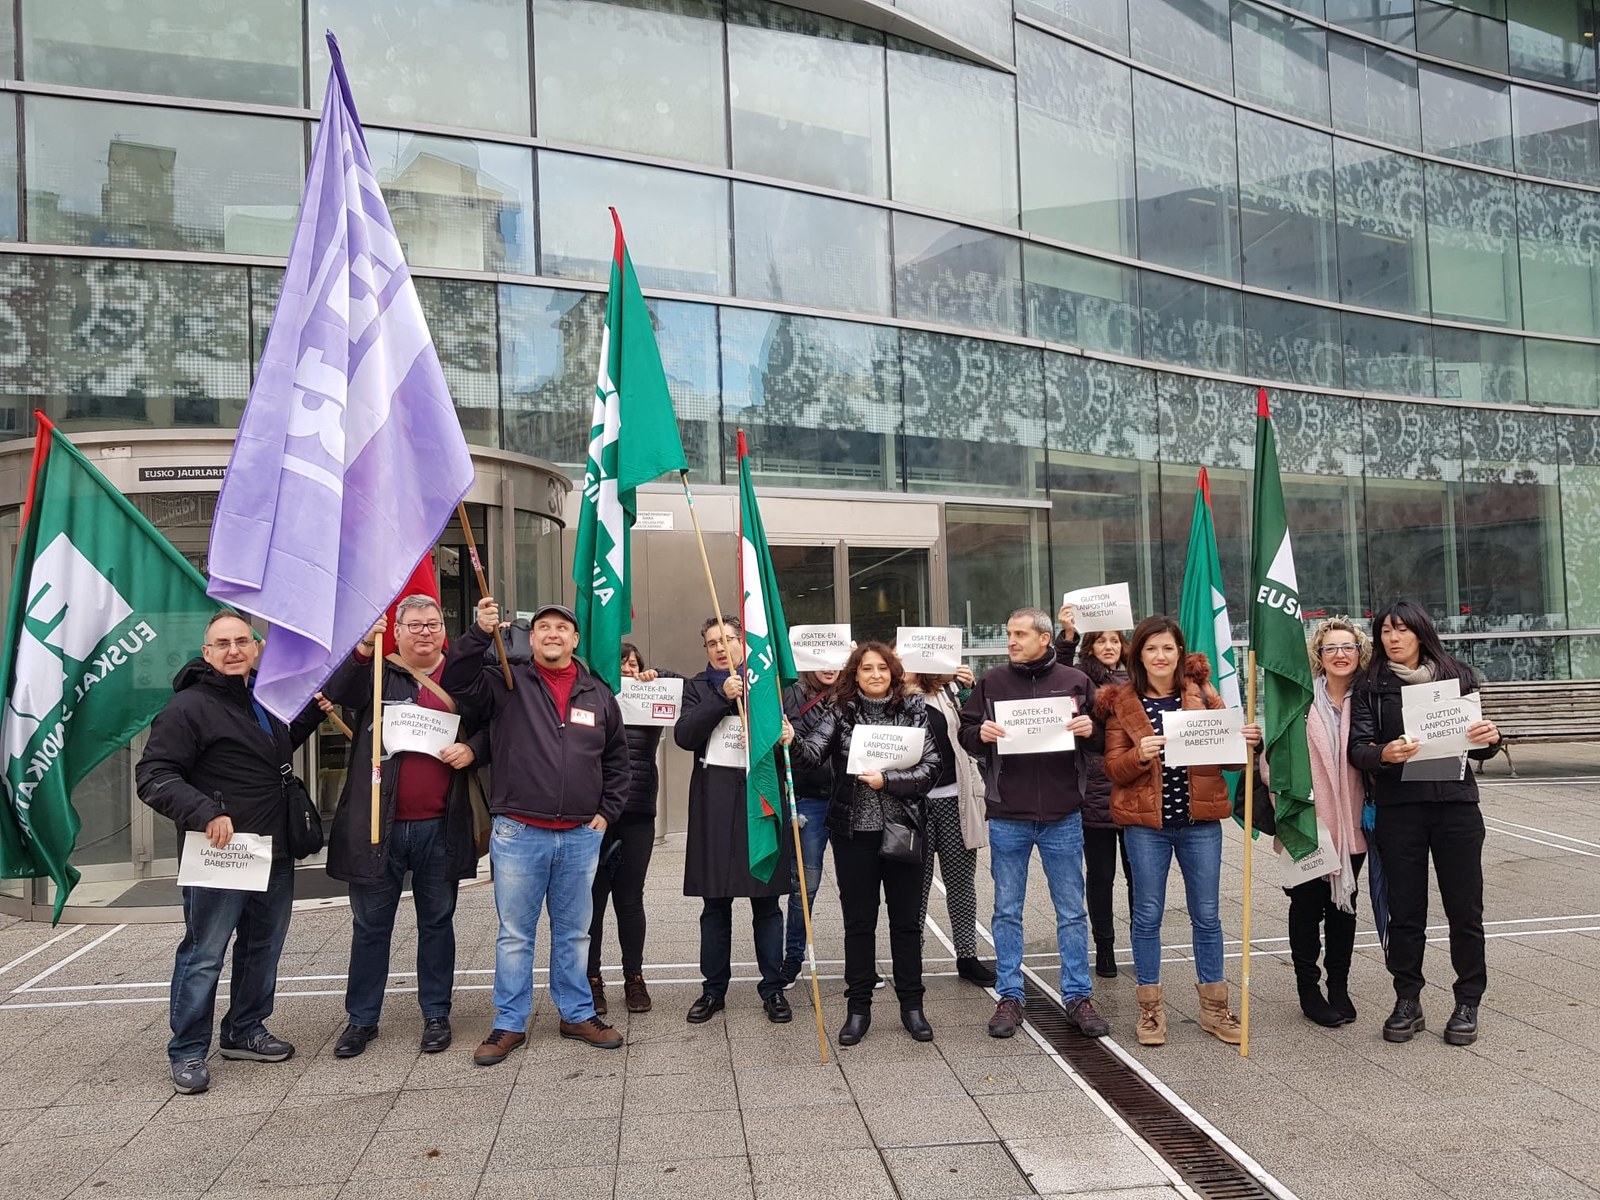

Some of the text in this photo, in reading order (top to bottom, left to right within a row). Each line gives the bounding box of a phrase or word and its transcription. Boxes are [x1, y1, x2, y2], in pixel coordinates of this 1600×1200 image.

[145, 469, 175, 478] EUSKO
[1081, 593, 1110, 602] GUZTION
[904, 643, 954, 651] MURRIZKETARIK
[622, 693, 675, 701] MURRIZKETARIK
[1012, 707, 1053, 717] OSATEK-EN
[1426, 707, 1461, 720] GUZTION
[401, 712, 442, 726] OSATEK-EN
[1004, 716, 1064, 727] MURRIZKETARIK
[1186, 719, 1222, 728] GUZTION
[1420, 715, 1470, 731] LANPOSTUAK
[391, 720, 449, 735] MURRIZKETARIK
[1027, 727, 1041, 735] EZ!!
[872, 733, 903, 742] GUZTION
[1180, 728, 1230, 738] LANPOSTUAK
[1427, 726, 1467, 740] BABESTU!!
[864, 741, 909, 752] LANPOSTUAK
[1185, 738, 1224, 746] BABESTU!!
[866, 750, 903, 760] BABESTU!!
[200, 849, 255, 860] LANPOSTUAK
[204, 859, 248, 869] BABESTU!!
